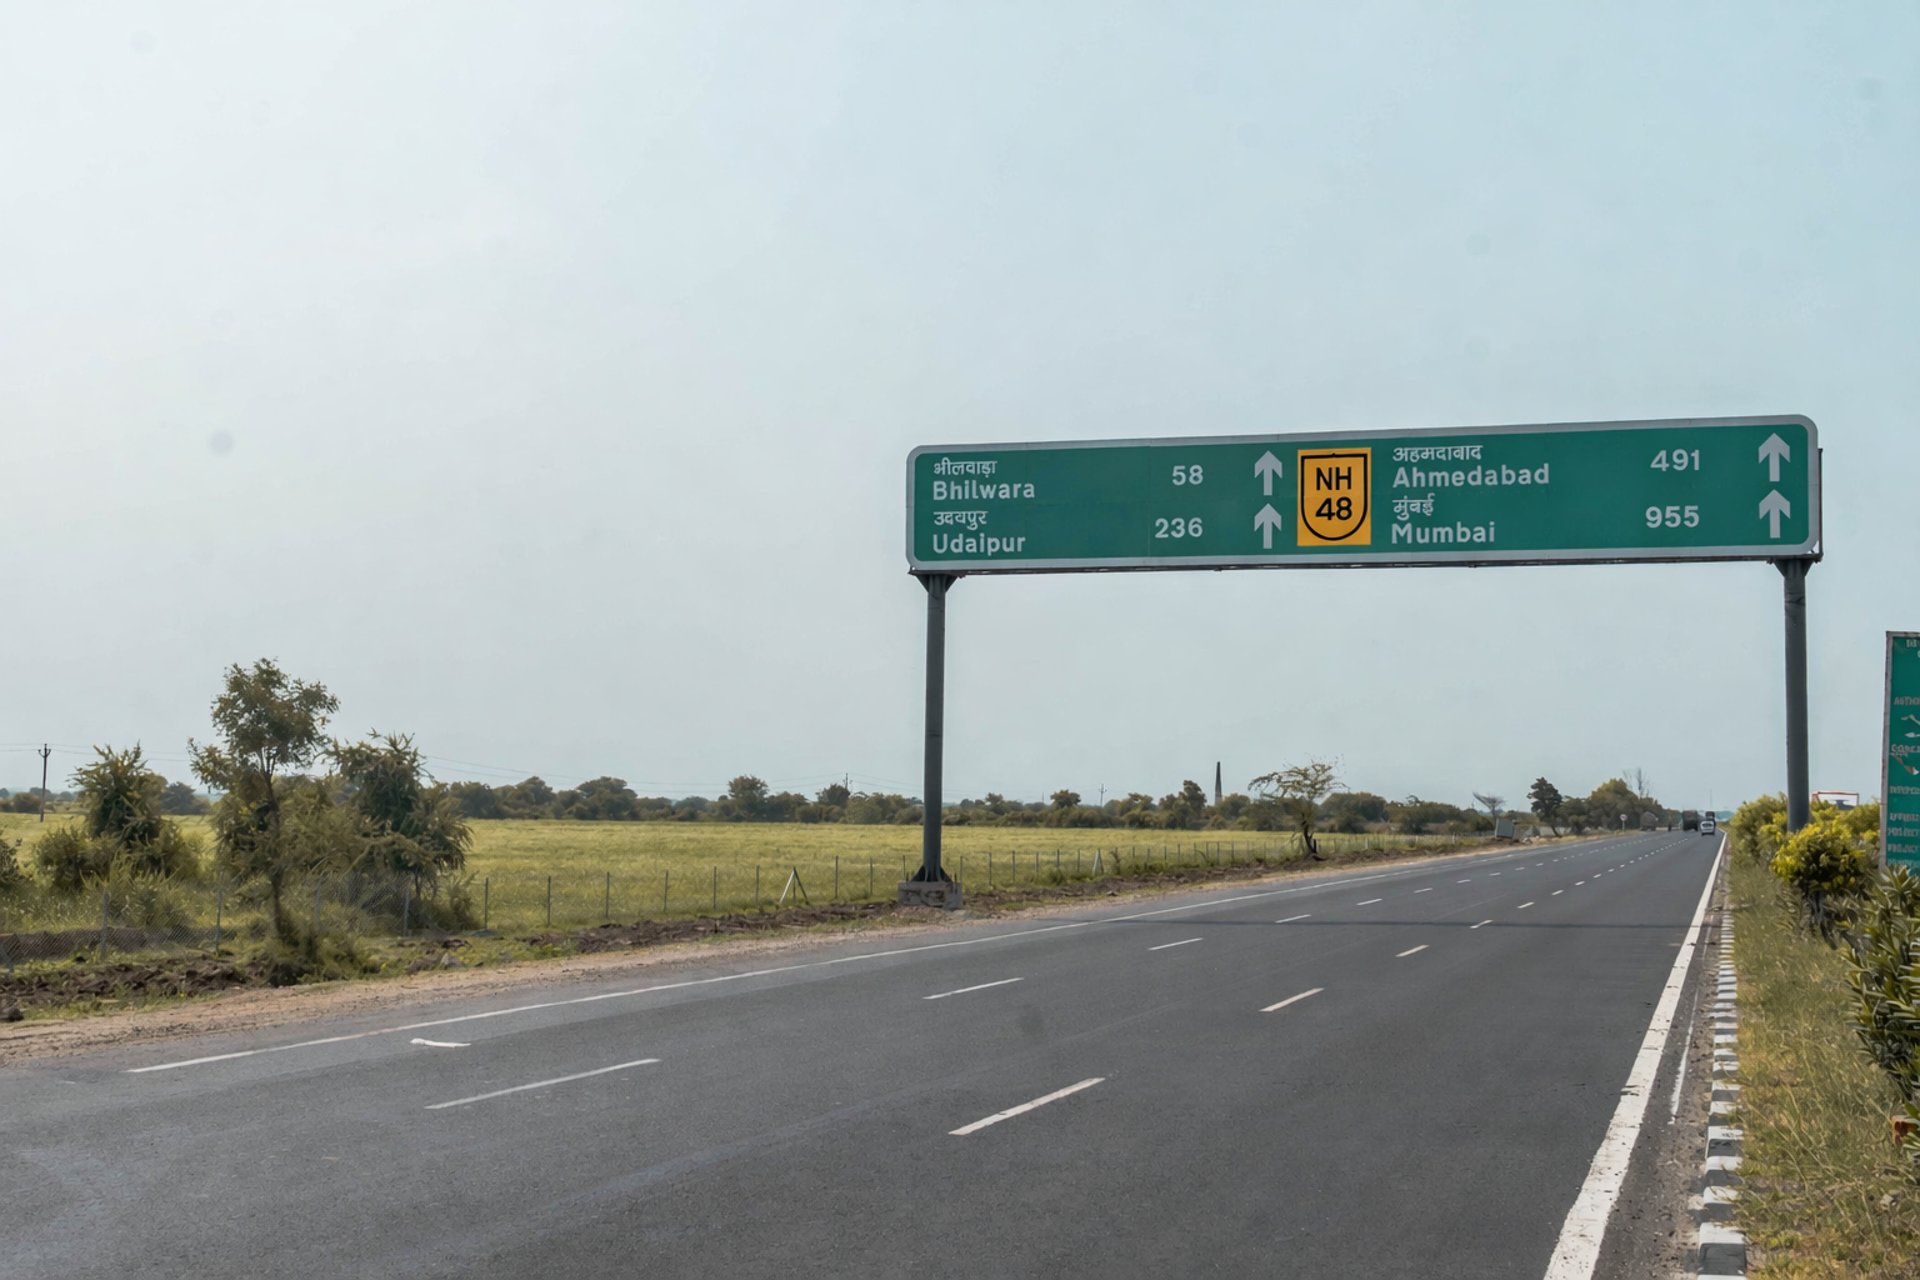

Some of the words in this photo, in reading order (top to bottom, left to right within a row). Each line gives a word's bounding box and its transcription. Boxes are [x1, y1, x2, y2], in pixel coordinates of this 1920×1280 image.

[934, 457, 998, 478] भीलवाड़ा
[1651, 449, 1702, 471] 491
[1172, 465, 1204, 486] 58
[1315, 467, 1352, 491] NH
[1393, 462, 1550, 487] Ahmedabad
[932, 479, 1035, 501] Bhilwara
[1315, 497, 1352, 521] 48
[1645, 505, 1700, 529] 955
[1154, 516, 1204, 539] 236
[1391, 521, 1495, 544] Mumbai
[933, 532, 1026, 556] Udaipur
